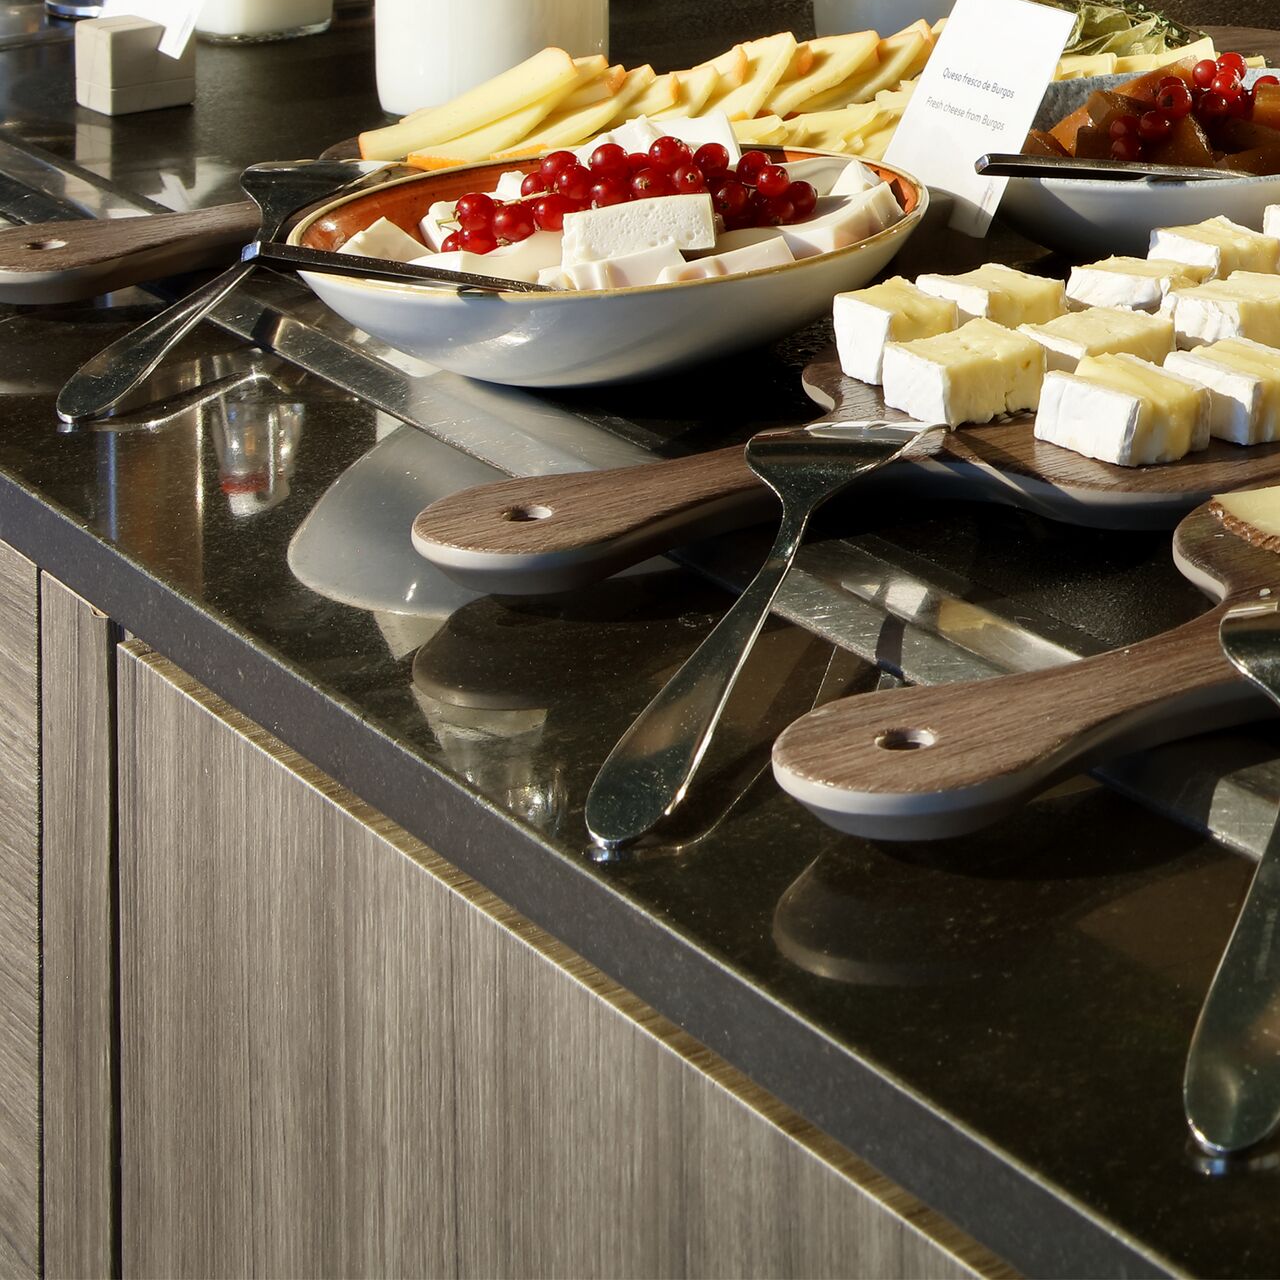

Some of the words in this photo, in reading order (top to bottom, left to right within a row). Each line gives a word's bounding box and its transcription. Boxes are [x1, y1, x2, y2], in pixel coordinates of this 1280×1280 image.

[942, 67, 962, 82] Queso
[962, 72, 982, 89] fresco
[982, 80, 991, 91] de
[991, 82, 1015, 99] Burgos
[926, 96, 944, 110] Fresh
[943, 102, 965, 118] cheese
[965, 108, 981, 123] from
[981, 114, 1005, 131] Burgos
